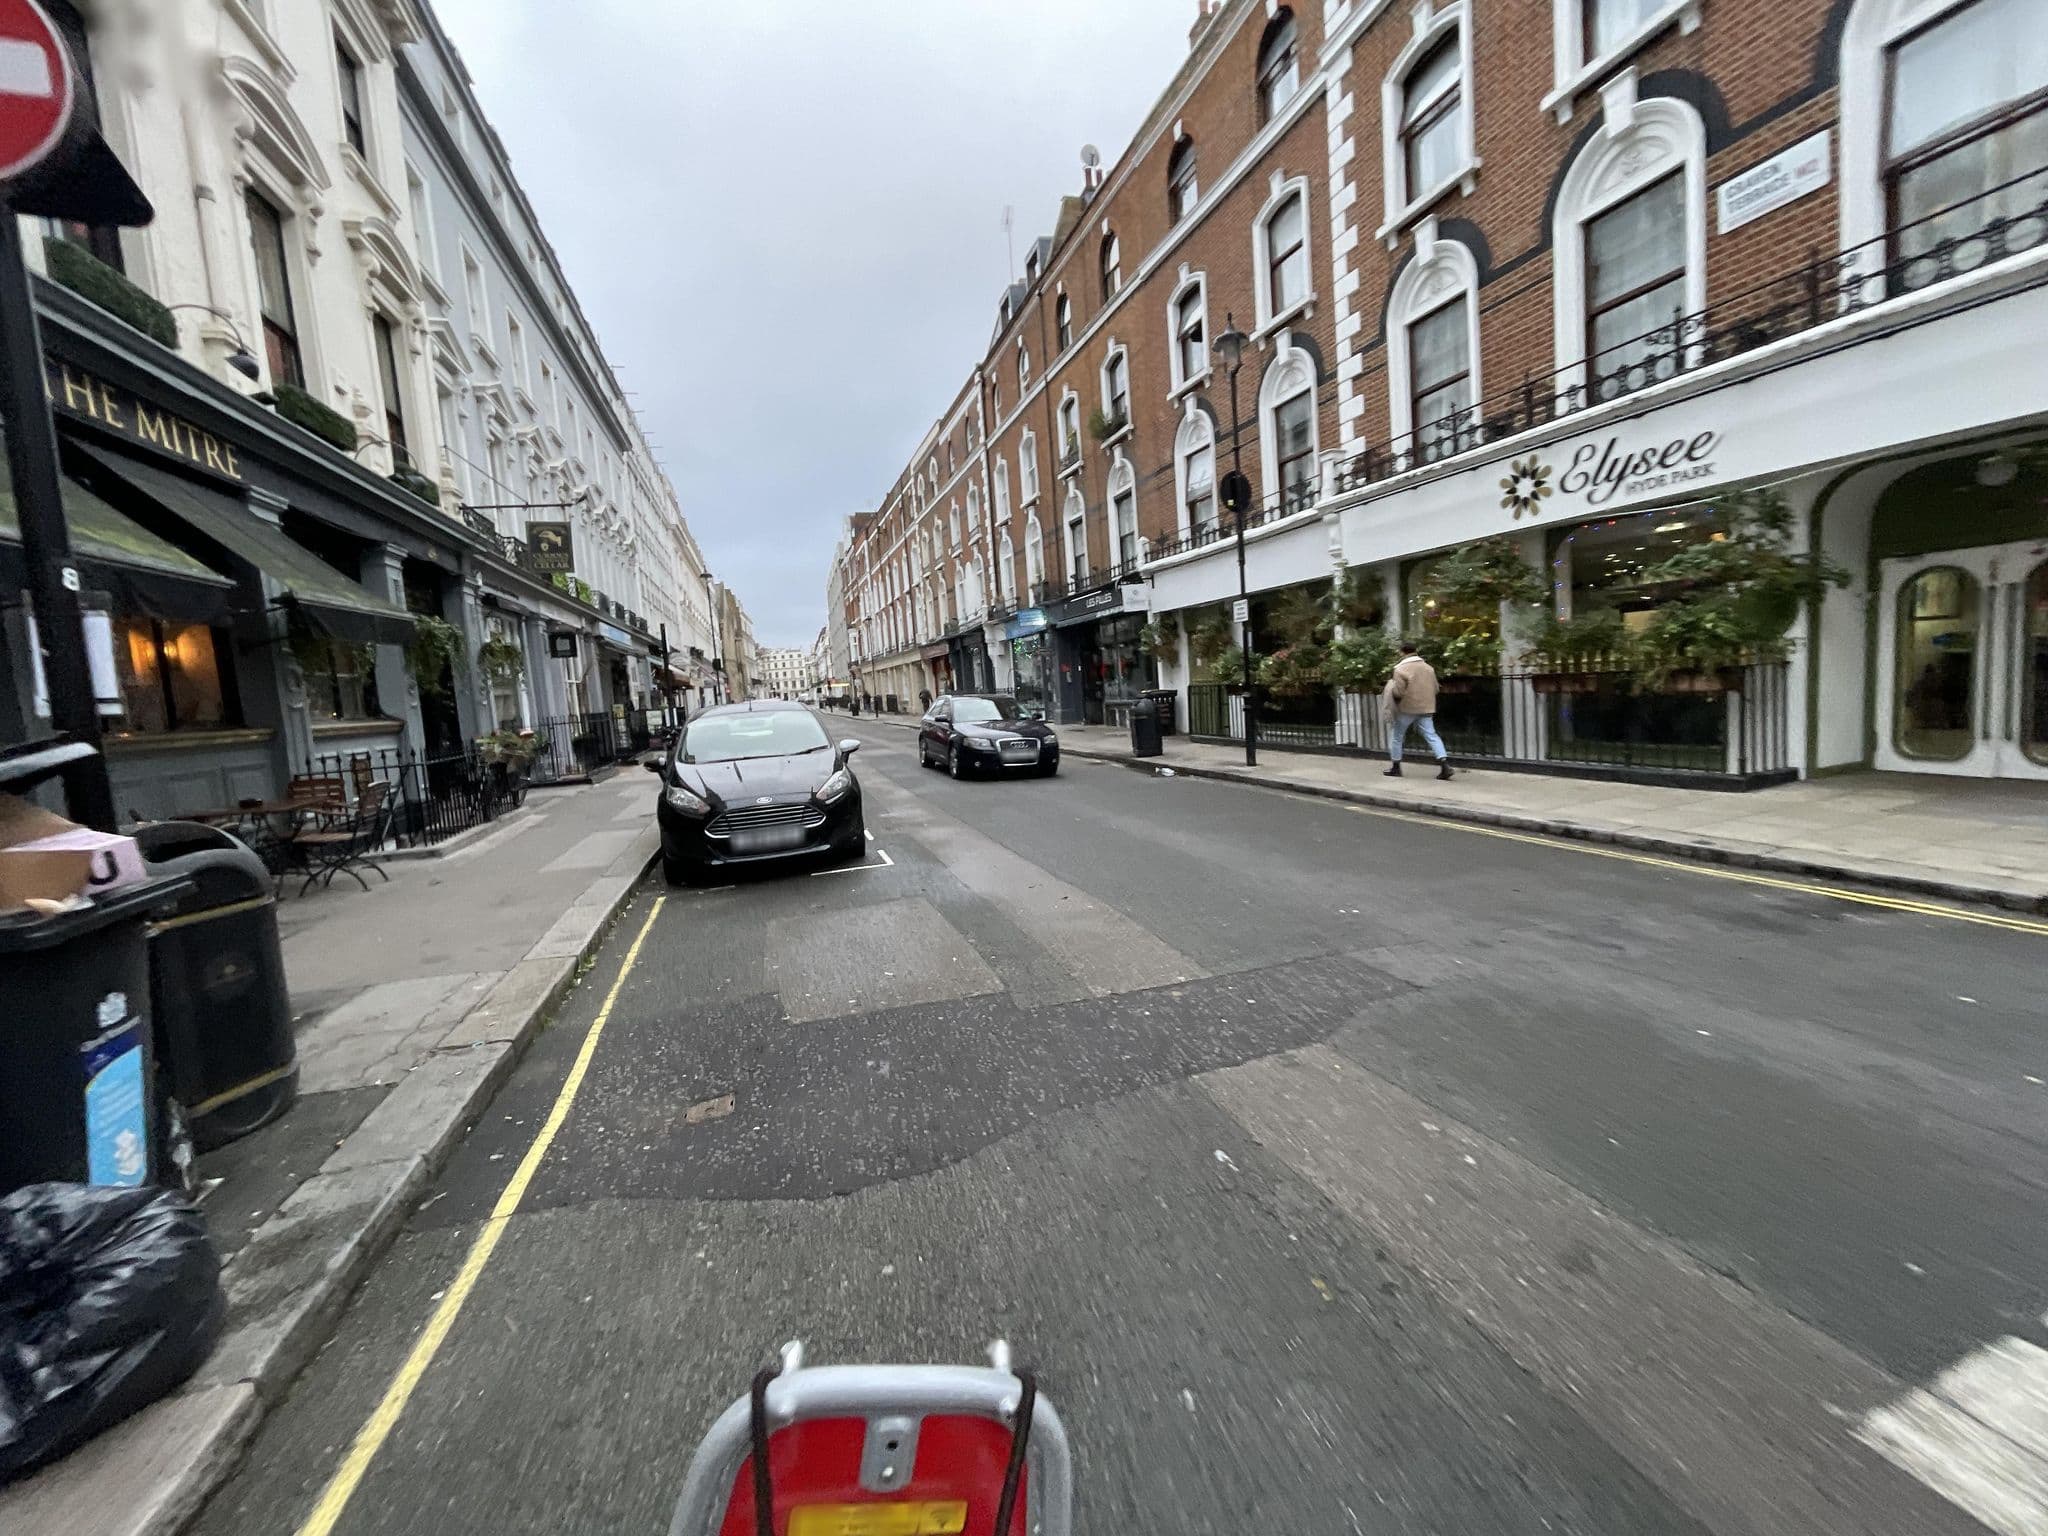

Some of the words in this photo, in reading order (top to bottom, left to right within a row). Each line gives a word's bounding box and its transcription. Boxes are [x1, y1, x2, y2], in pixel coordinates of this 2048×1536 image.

[50, 364, 125, 428] HE
[136, 400, 242, 480] MITRE
[1560, 430, 1725, 505] Elysee
[1626, 472, 1667, 496] HYDE
[1672, 462, 1717, 484] PARK
